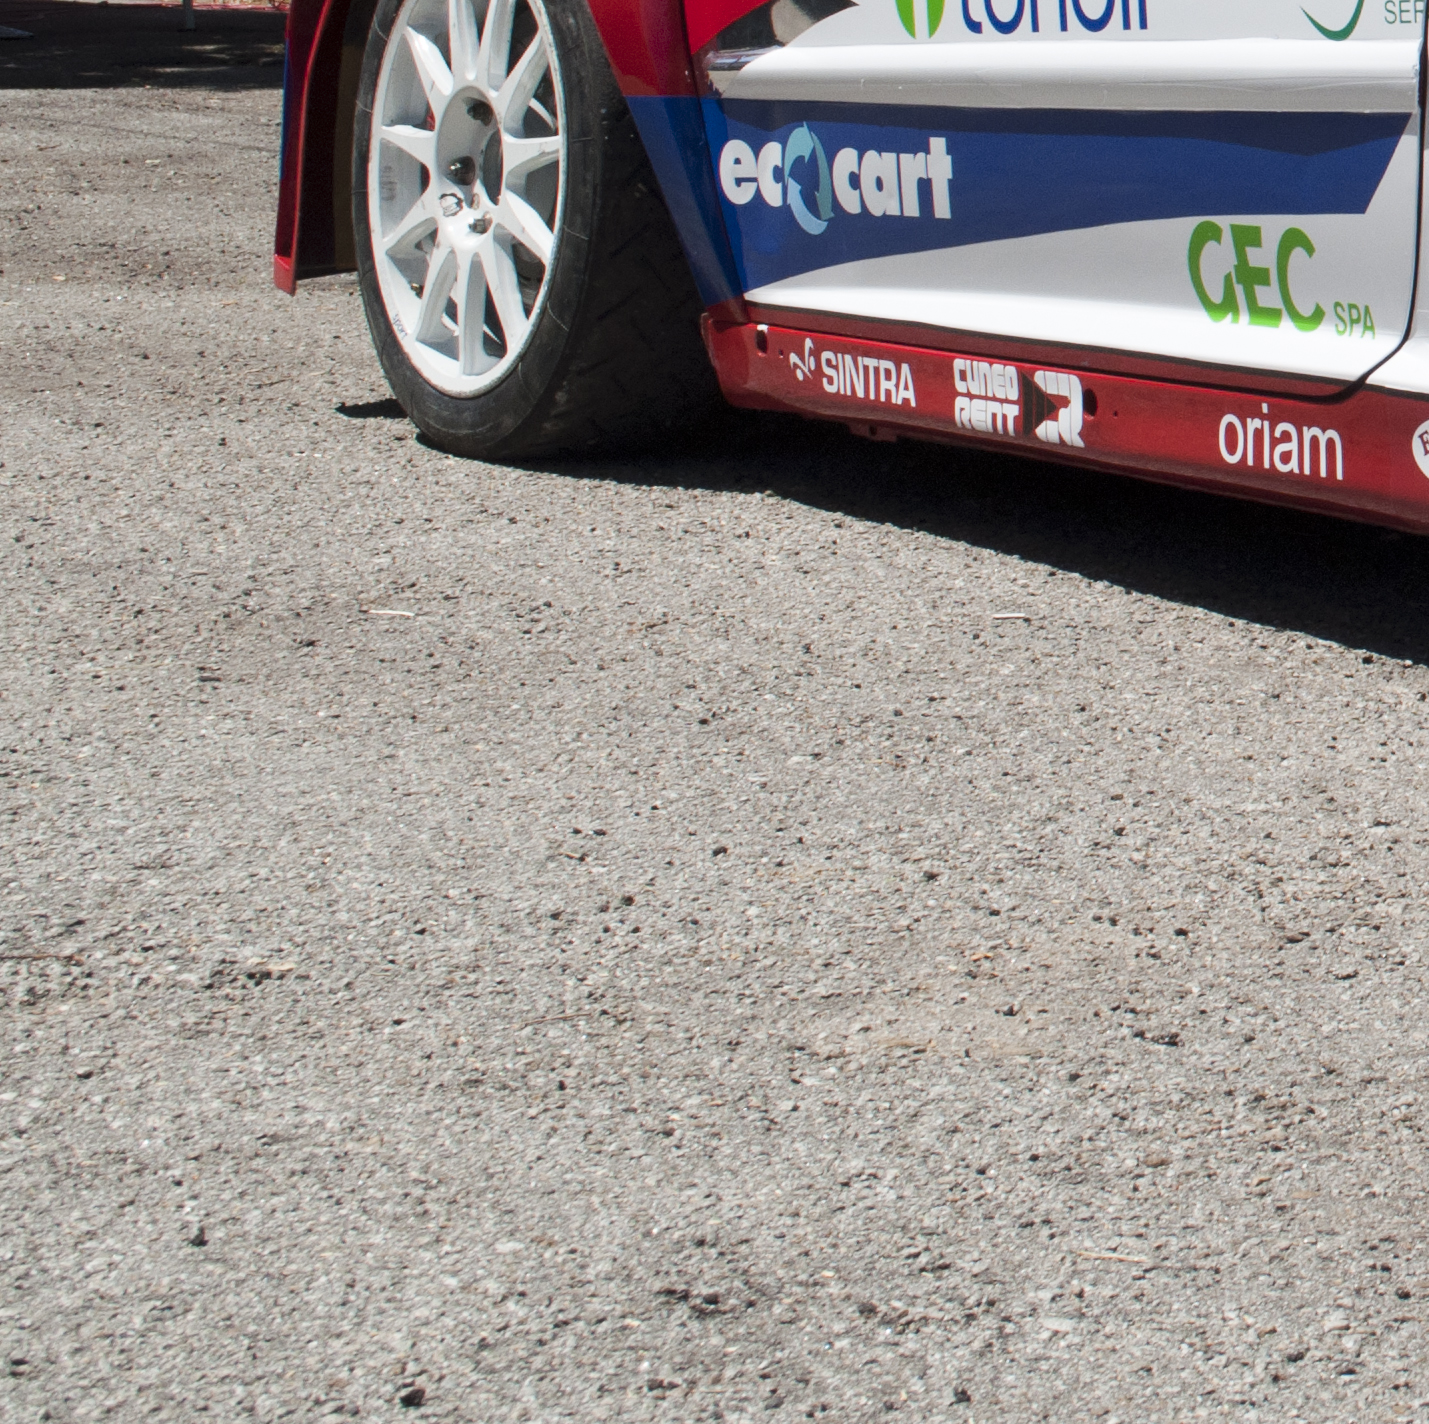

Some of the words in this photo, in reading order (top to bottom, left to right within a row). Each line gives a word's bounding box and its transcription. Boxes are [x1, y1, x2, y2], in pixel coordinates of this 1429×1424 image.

[1187, 219, 1327, 333] GEC
[1334, 301, 1376, 340] SPA
[819, 351, 917, 408] SINTRA
[952, 357, 1020, 403] CUNEO
[953, 395, 1021, 438] RENT
[1217, 402, 1344, 481] oriam
